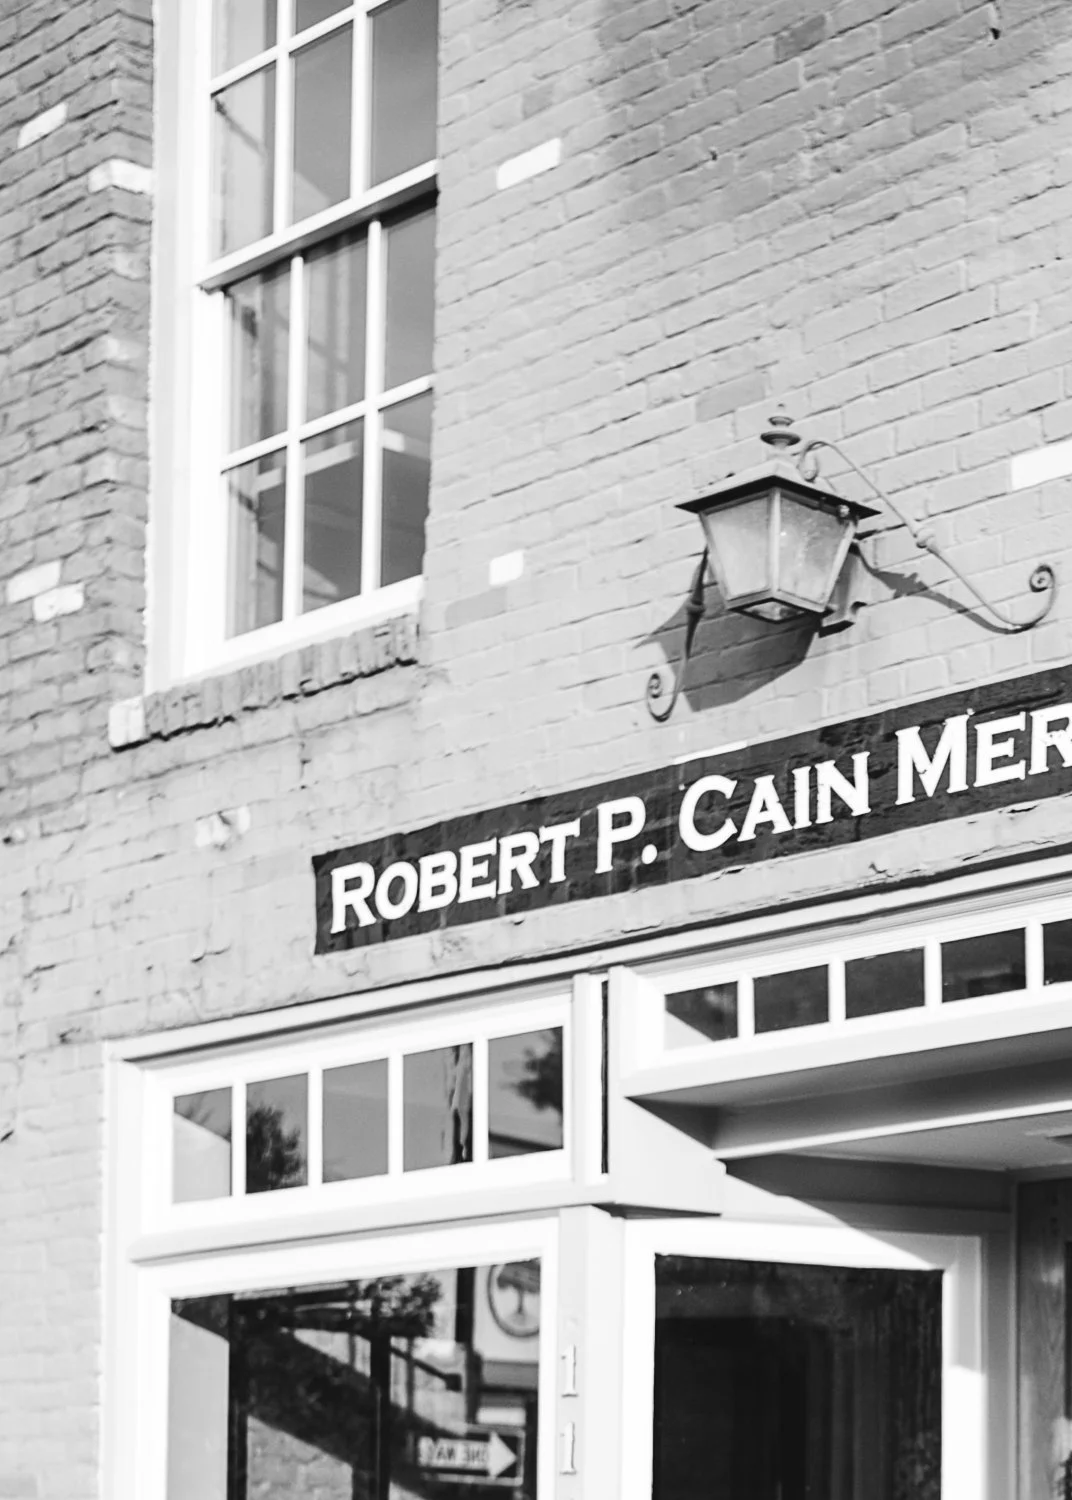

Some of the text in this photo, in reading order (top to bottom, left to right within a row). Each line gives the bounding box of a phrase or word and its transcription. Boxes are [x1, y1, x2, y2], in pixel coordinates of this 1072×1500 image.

[330, 817, 581, 934] ROBERT
[594, 796, 658, 874] P.
[678, 751, 872, 852] CAIN
